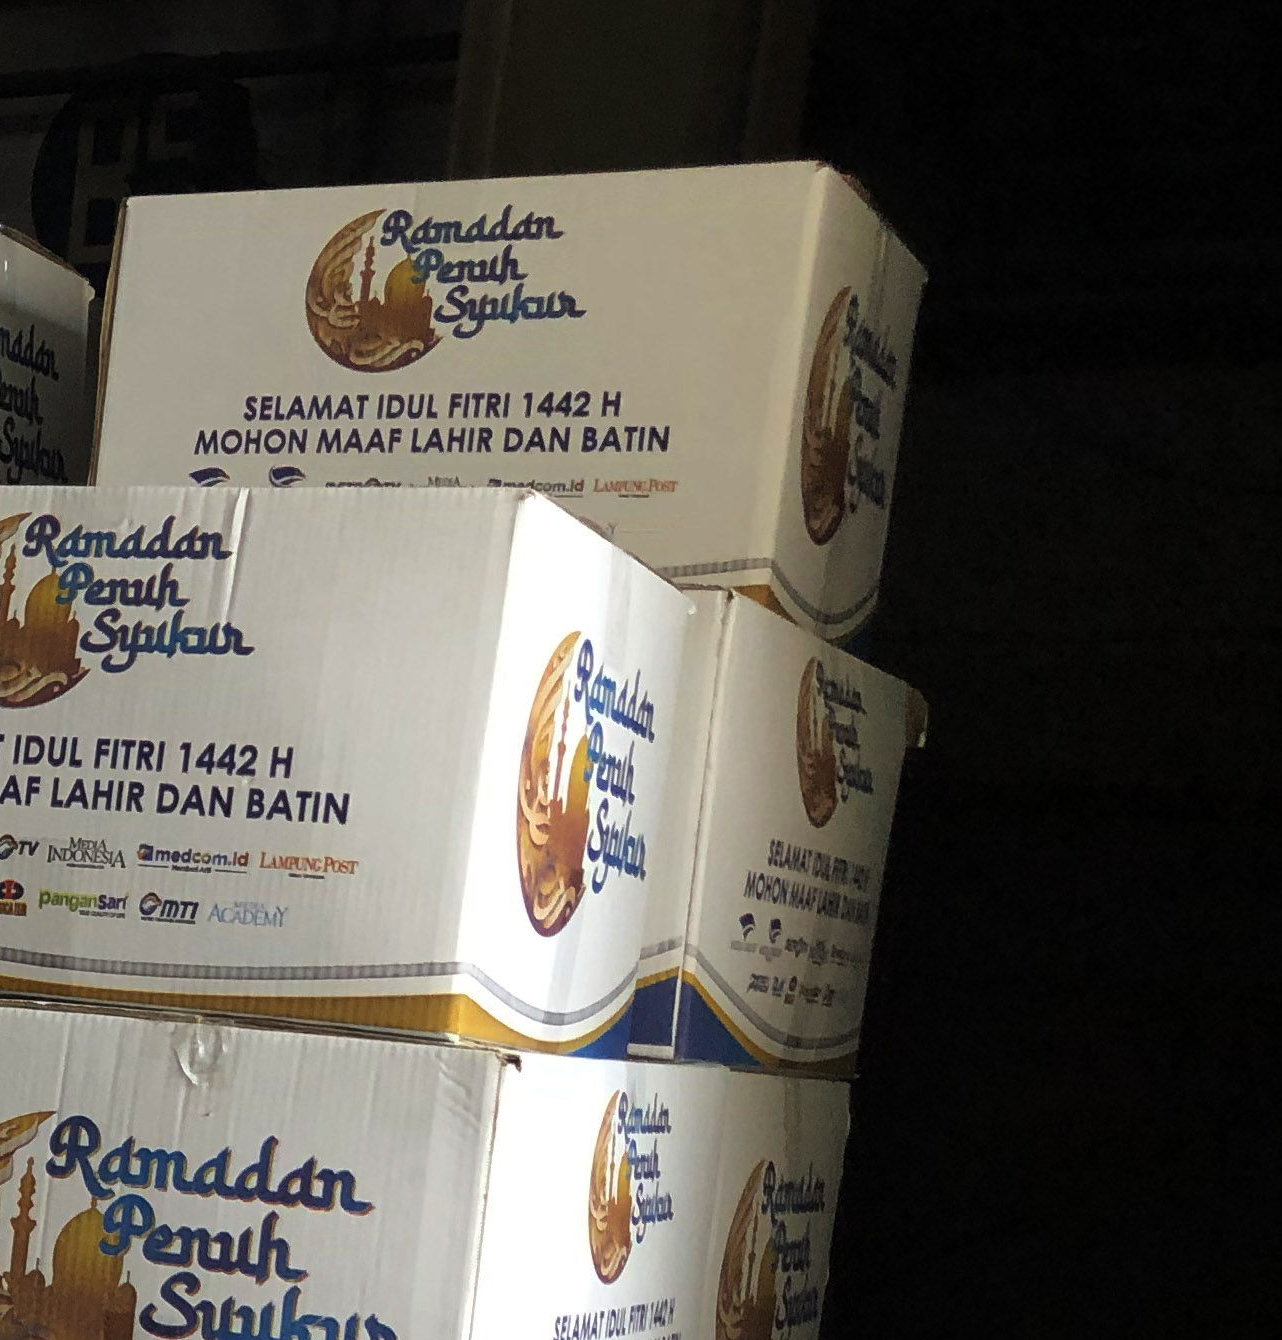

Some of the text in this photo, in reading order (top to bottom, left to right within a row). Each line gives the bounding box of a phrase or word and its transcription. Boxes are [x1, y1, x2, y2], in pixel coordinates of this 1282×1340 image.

[381, 204, 564, 253] Ramadan
[410, 245, 527, 284] Penuh
[434, 283, 587, 338] Syukur
[244, 391, 622, 421] SELAMAT IDUL FITRI 1442 H
[194, 426, 670, 455] MOHON MAAF LAHIR DAN BATIN
[21, 514, 232, 569] Ramadan
[55, 562, 190, 610] Penuh
[80, 609, 255, 673] Syukur
[13, 733, 83, 768] IDUL
[94, 738, 164, 772] FITRI
[178, 742, 258, 778] 1442
[270, 747, 294, 779] H
[50, 777, 143, 812] LAHIR
[156, 783, 233, 819] DAN
[245, 788, 350, 824] BATIN
[324, 857, 359, 874] POST
[45, 1114, 375, 1215] Ramadan
[99, 1193, 308, 1286] Penuh
